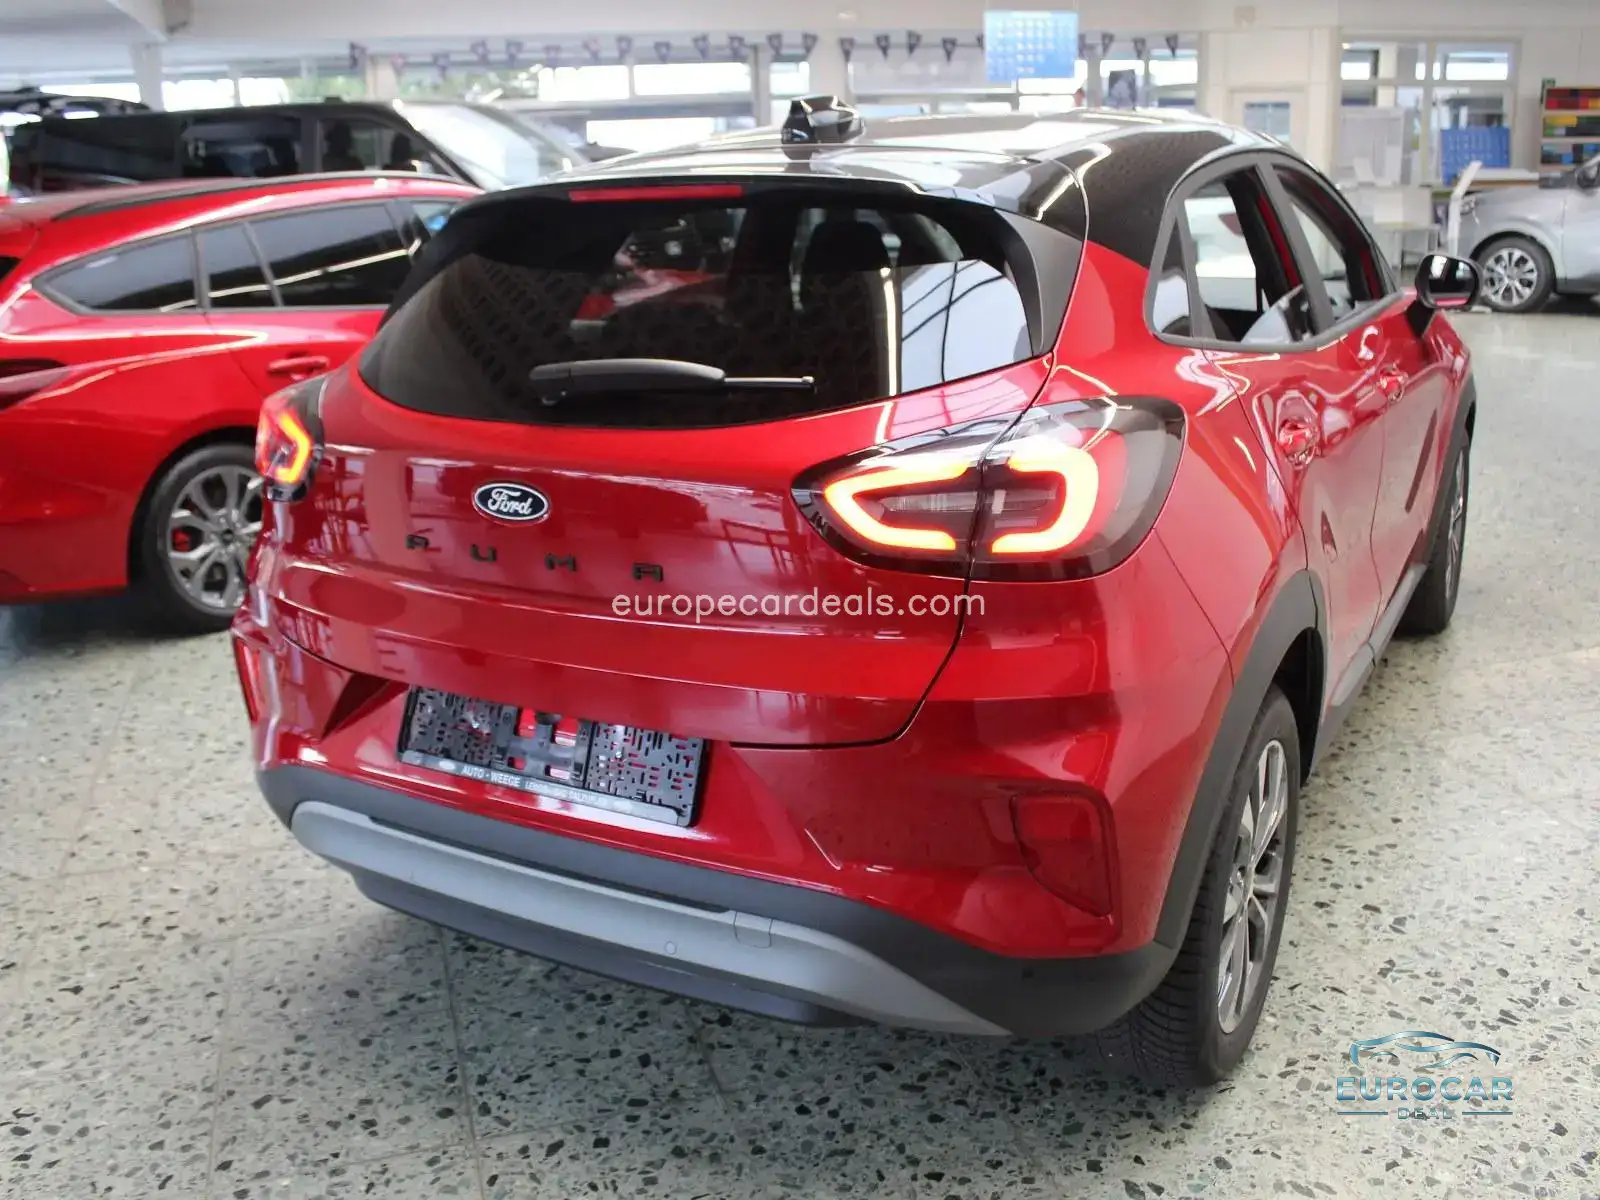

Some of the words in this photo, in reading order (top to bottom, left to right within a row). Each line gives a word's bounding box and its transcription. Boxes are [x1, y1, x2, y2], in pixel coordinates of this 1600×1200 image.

[487, 487, 533, 515] Ford
[406, 534, 664, 583] PUMA
[460, 765, 485, 780] AUTO
